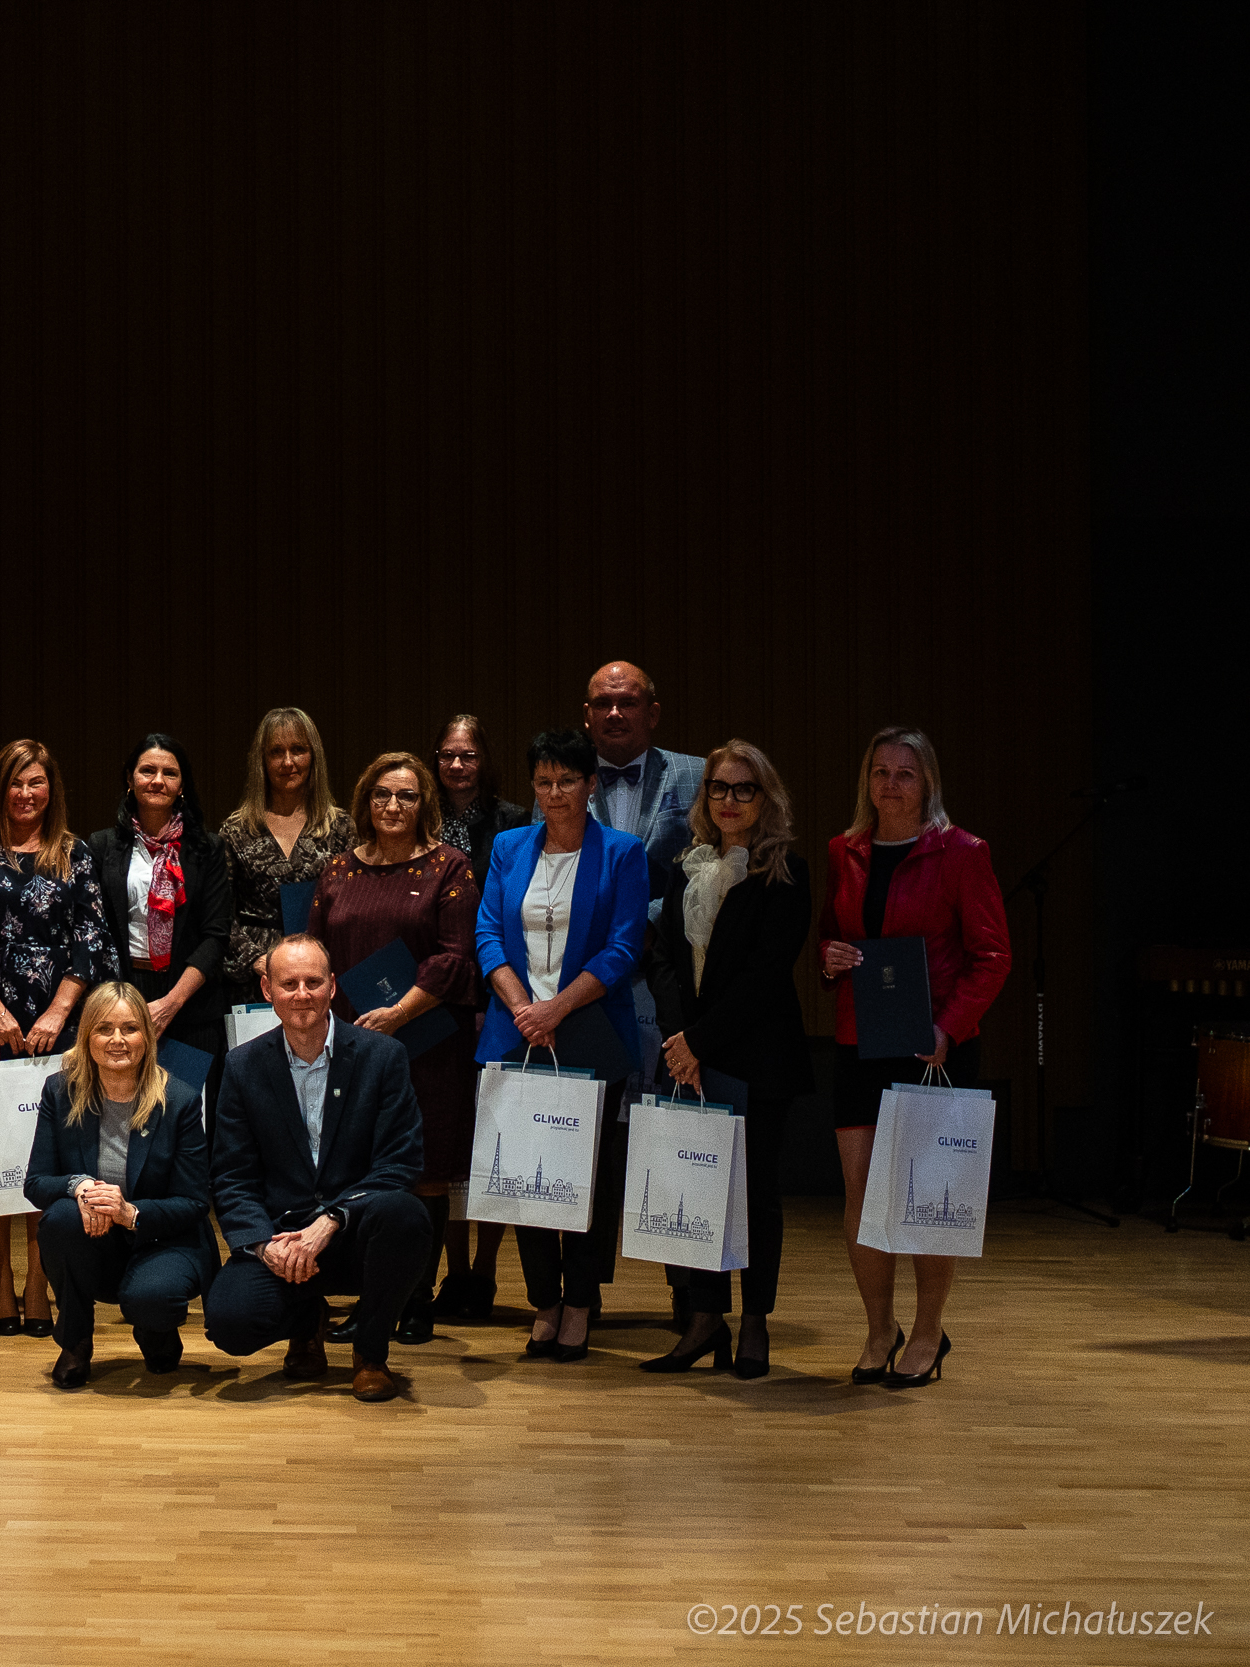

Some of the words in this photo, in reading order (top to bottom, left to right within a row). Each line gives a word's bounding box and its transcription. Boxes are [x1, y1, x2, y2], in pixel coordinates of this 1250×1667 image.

[18, 1102, 41, 1112] GLIW
[533, 1113, 579, 1127] GLIWICE
[938, 1136, 977, 1148] GLIWICE
[677, 1150, 718, 1163] GLIWICE
